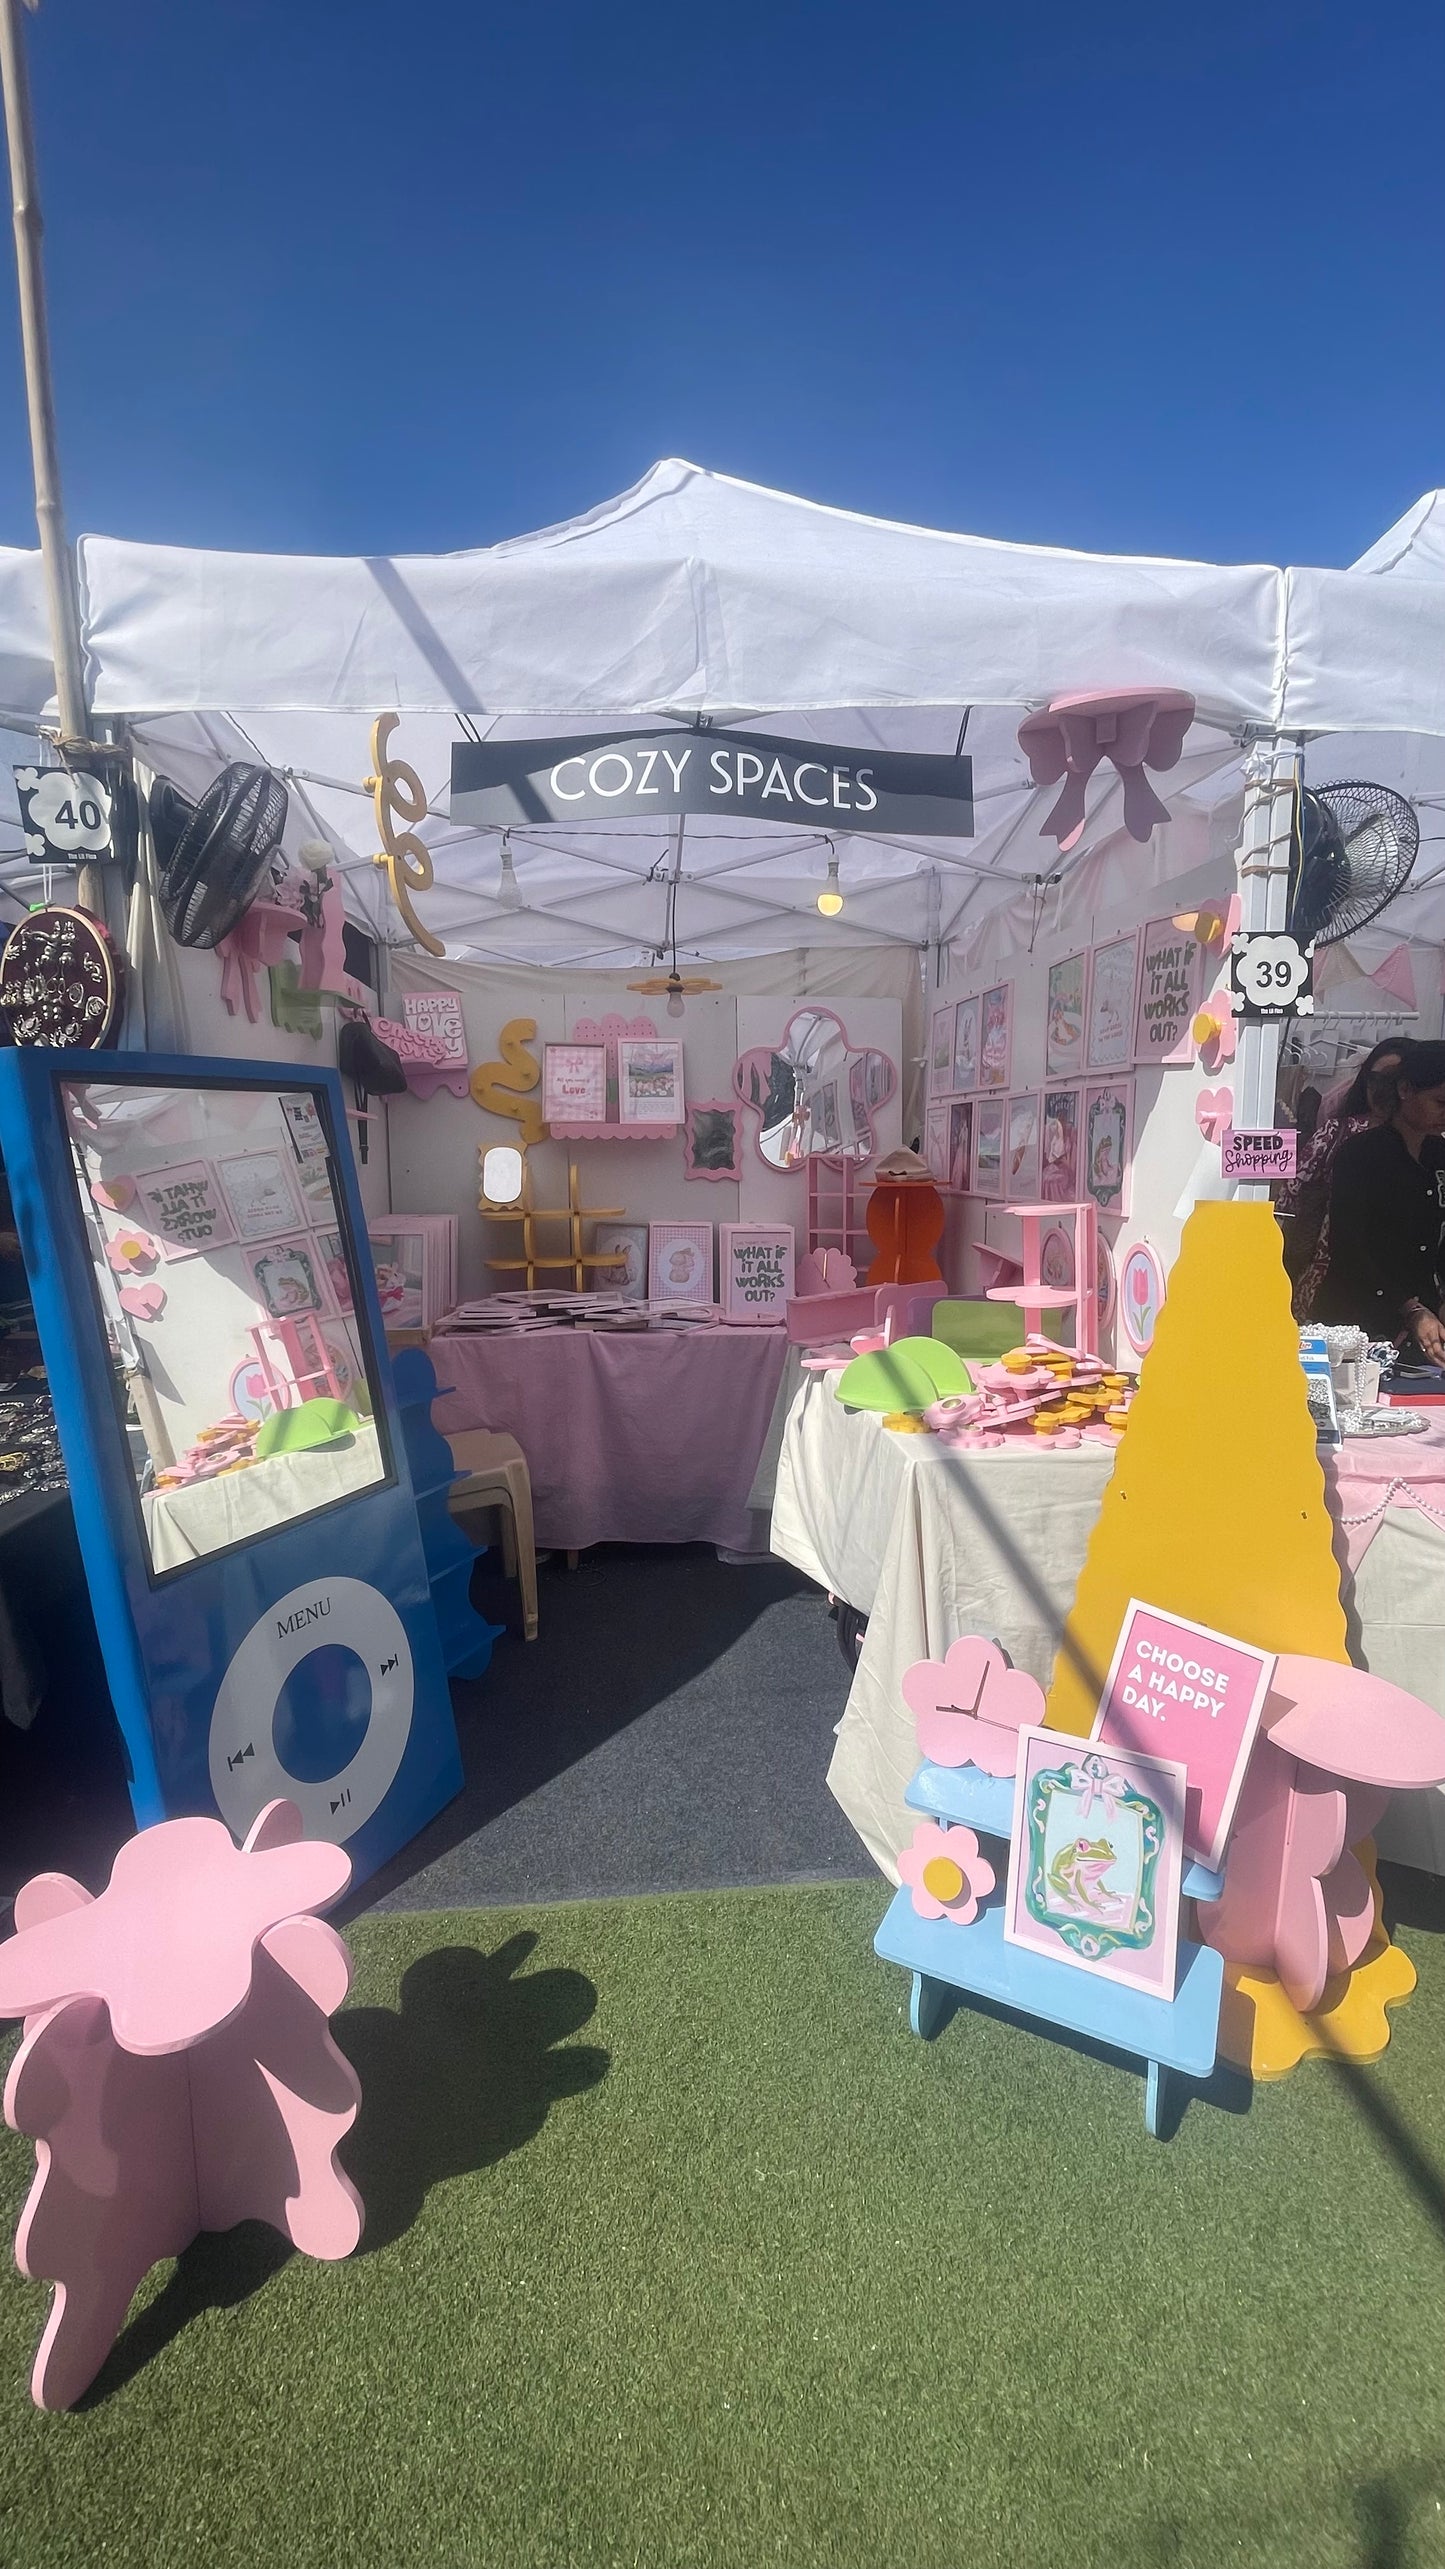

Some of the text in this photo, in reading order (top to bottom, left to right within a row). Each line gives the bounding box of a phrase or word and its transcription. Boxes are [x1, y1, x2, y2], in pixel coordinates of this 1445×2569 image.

[550, 749, 879, 812] COZY SPACES
[55, 800, 101, 830] 40
[1146, 947, 1182, 973] WHAT
[1164, 968, 1189, 993] ALL
[1256, 961, 1291, 987] 39
[1144, 991, 1190, 1020] WORKS
[1150, 1021, 1178, 1042] OUT?
[1233, 1136, 1283, 1151] SPEED
[1225, 1150, 1293, 1173] Shopping
[733, 1246, 773, 1259] WHAT
[757, 1260, 783, 1273] ALL
[735, 1273, 785, 1288] WORKS
[744, 1290, 776, 1302] OUT?
[275, 1597, 332, 1640] MENU
[1136, 1640, 1230, 1694] CHOOSE
[1121, 1685, 1166, 1722] DAY.
[1127, 1663, 1226, 1718] A HAPPY
